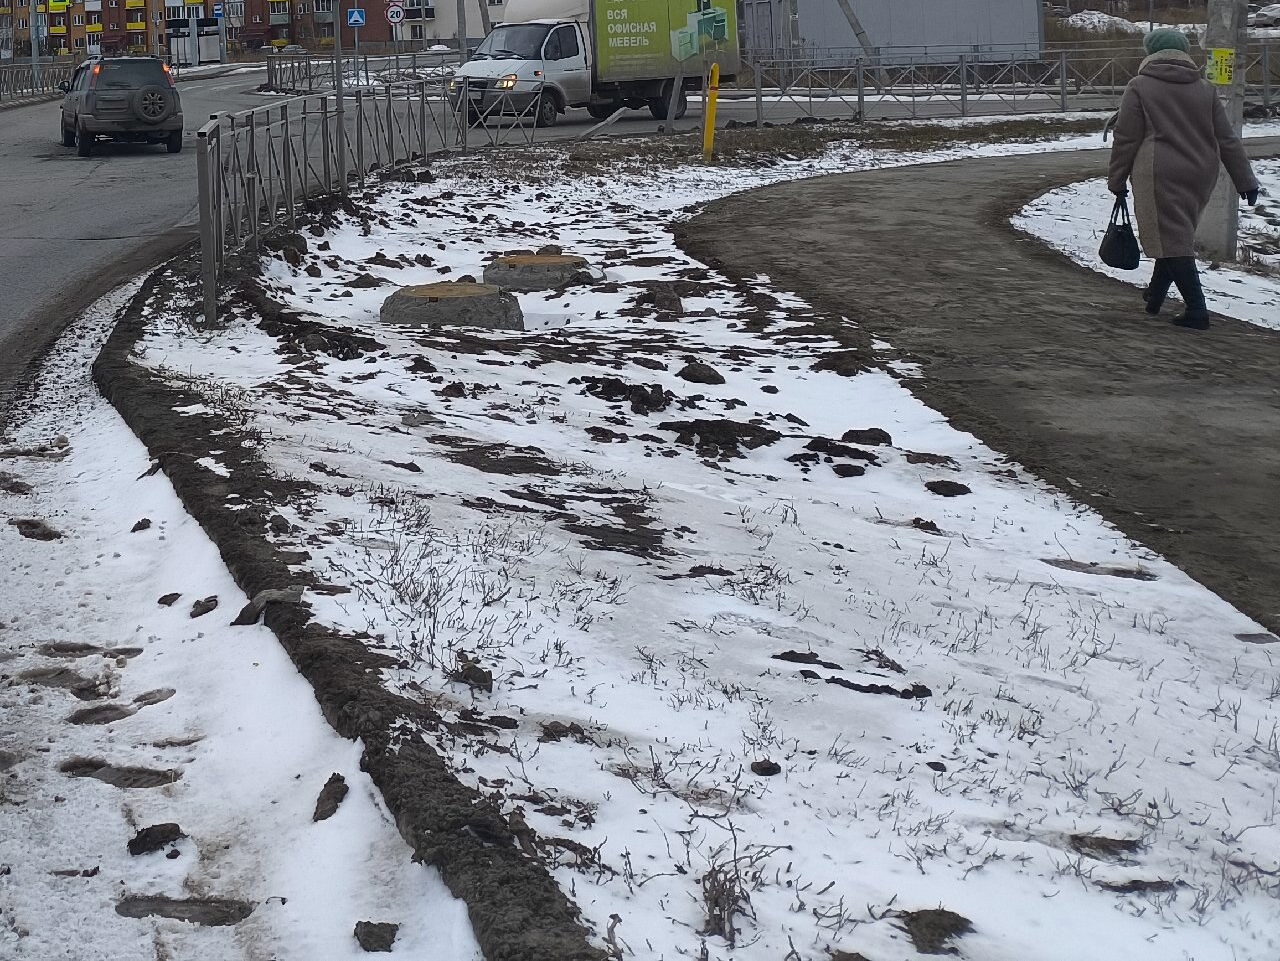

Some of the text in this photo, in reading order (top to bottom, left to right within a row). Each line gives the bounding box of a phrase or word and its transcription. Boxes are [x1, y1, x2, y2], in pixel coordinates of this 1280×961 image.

[389, 10, 401, 19] 20
[607, 9, 628, 20] ВСЯ
[607, 22, 657, 34] ОФИСНАЯ
[609, 36, 649, 47] МЕБЕЛЬ
